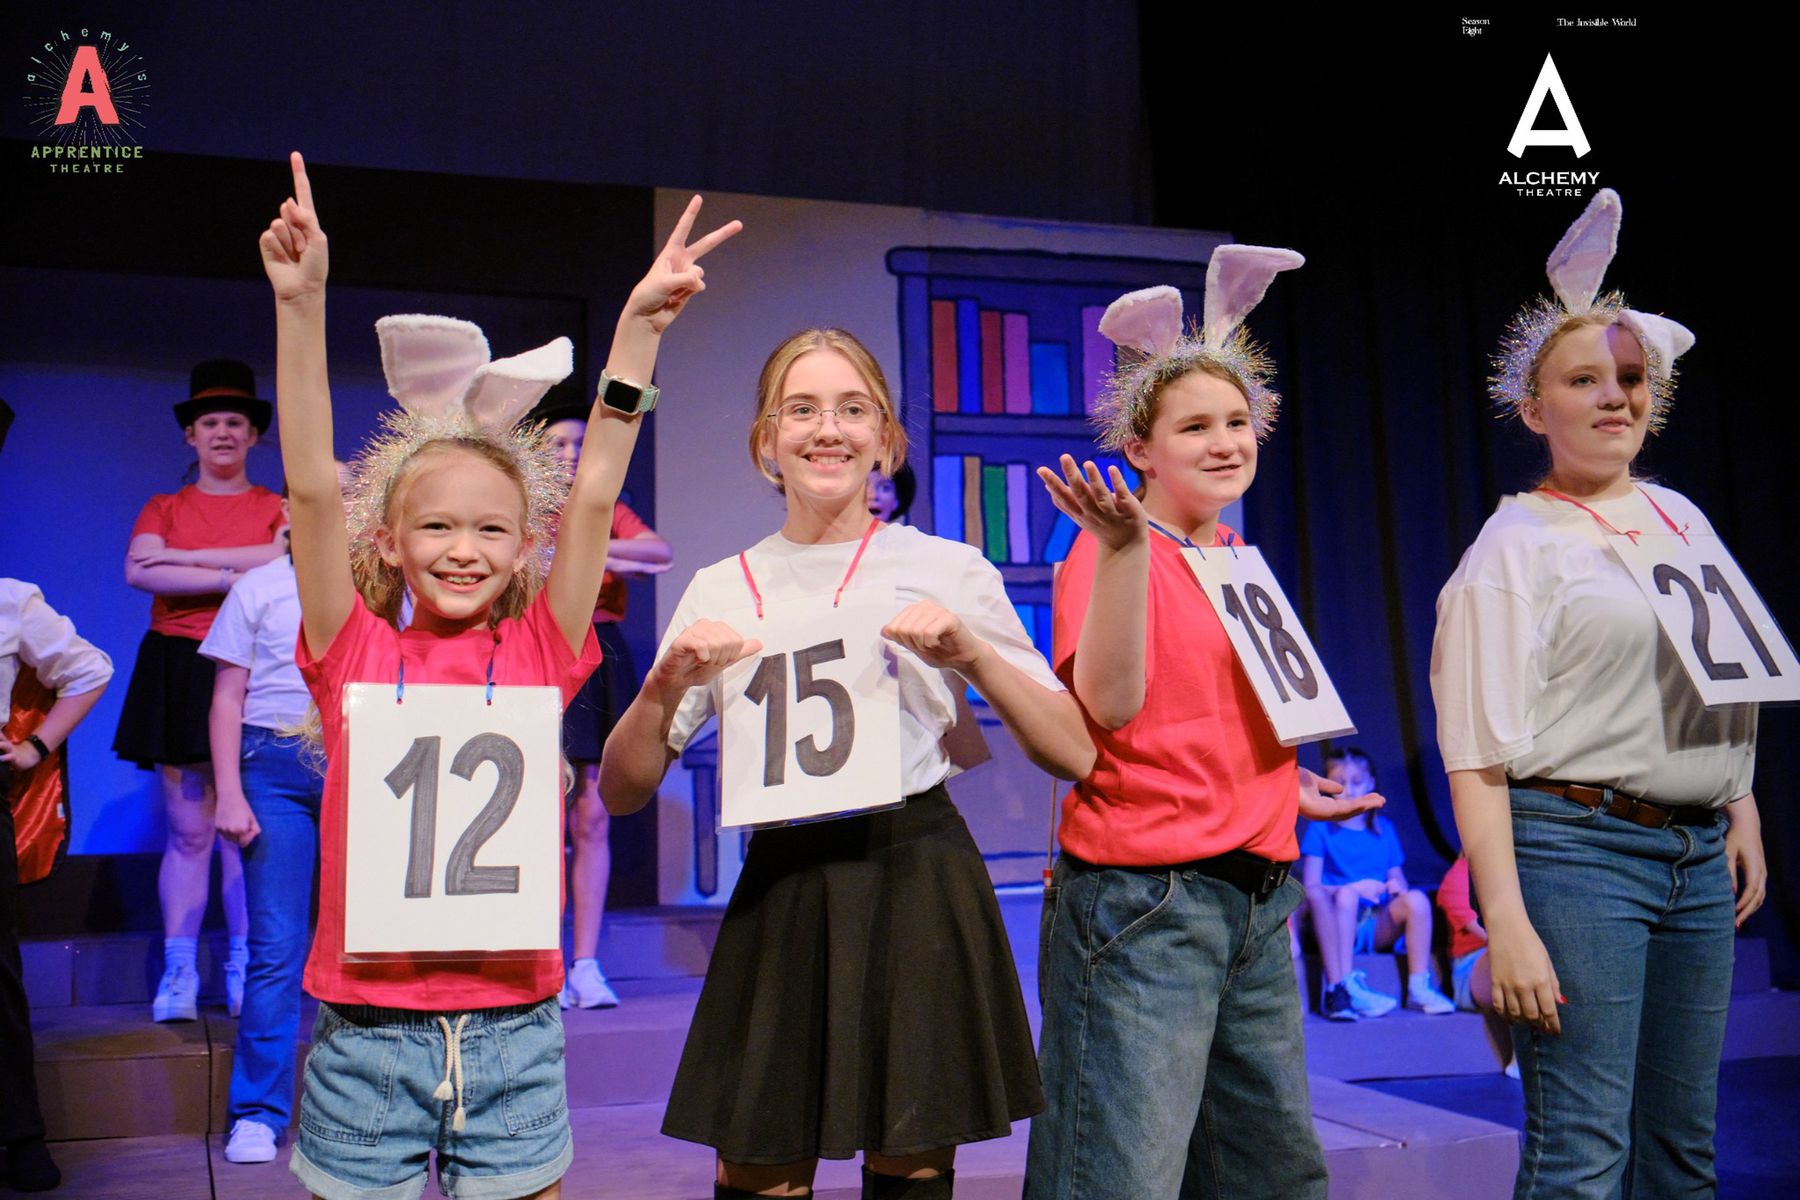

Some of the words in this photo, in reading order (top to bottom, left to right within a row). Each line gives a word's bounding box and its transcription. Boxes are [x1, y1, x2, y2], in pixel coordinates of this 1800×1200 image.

[1221, 581, 1319, 704] 18
[1653, 563, 1782, 681] 21
[744, 638, 855, 788] 15
[384, 731, 525, 899] 12
